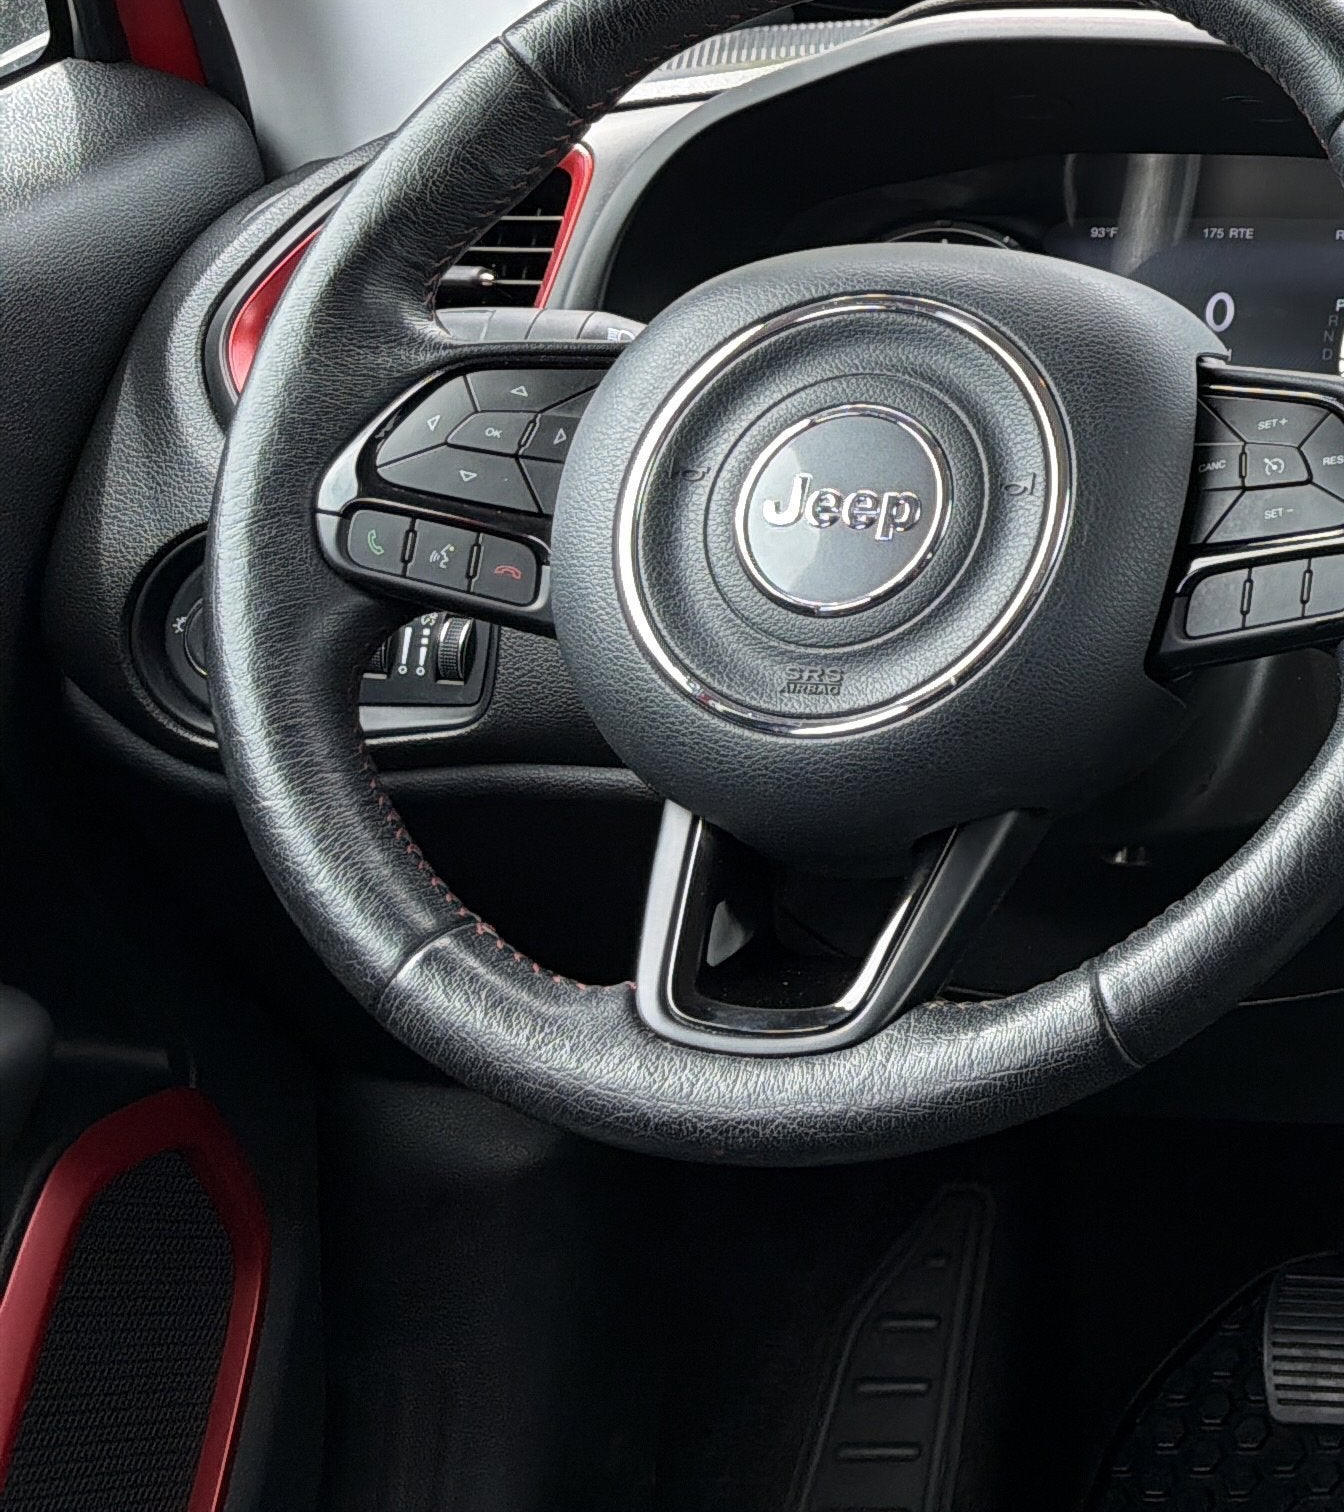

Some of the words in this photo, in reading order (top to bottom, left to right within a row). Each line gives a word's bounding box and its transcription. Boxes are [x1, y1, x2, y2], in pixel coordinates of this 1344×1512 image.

[1090, 227, 1119, 239] 93°F
[1203, 228, 1225, 239] 175
[1229, 228, 1255, 239] RTE
[1206, 292, 1236, 333] 0
[1328, 315, 1339, 327] R
[1324, 331, 1334, 342] N
[1322, 348, 1333, 361] D
[1257, 418, 1279, 430] SET
[484, 426, 503, 439] OK
[1322, 454, 1344, 466] RES
[763, 472, 921, 541] Jeep
[1264, 506, 1285, 519] SET
[785, 667, 843, 682] SRS
